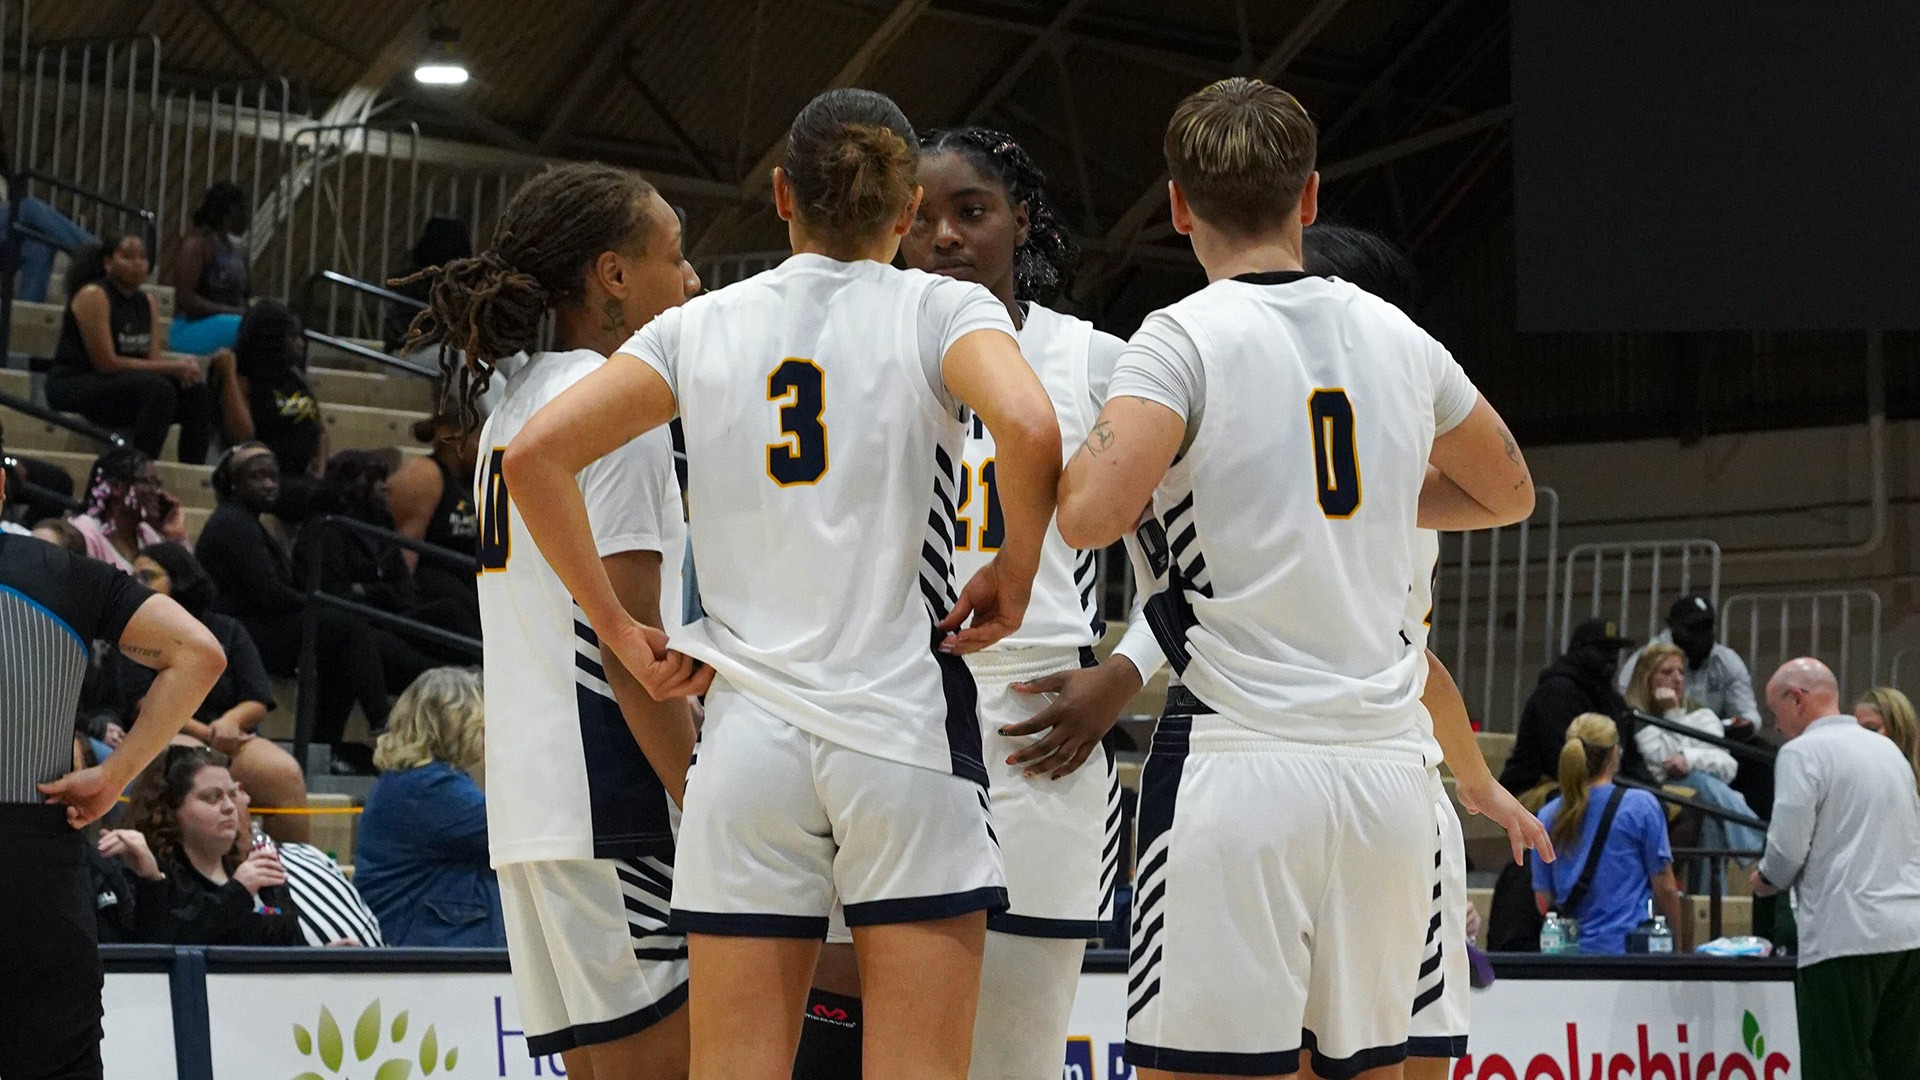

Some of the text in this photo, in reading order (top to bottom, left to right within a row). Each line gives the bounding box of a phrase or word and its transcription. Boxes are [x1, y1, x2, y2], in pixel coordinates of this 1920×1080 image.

[766, 357, 829, 488] 3
[1307, 387, 1362, 520] 0
[476, 446, 512, 576] 0
